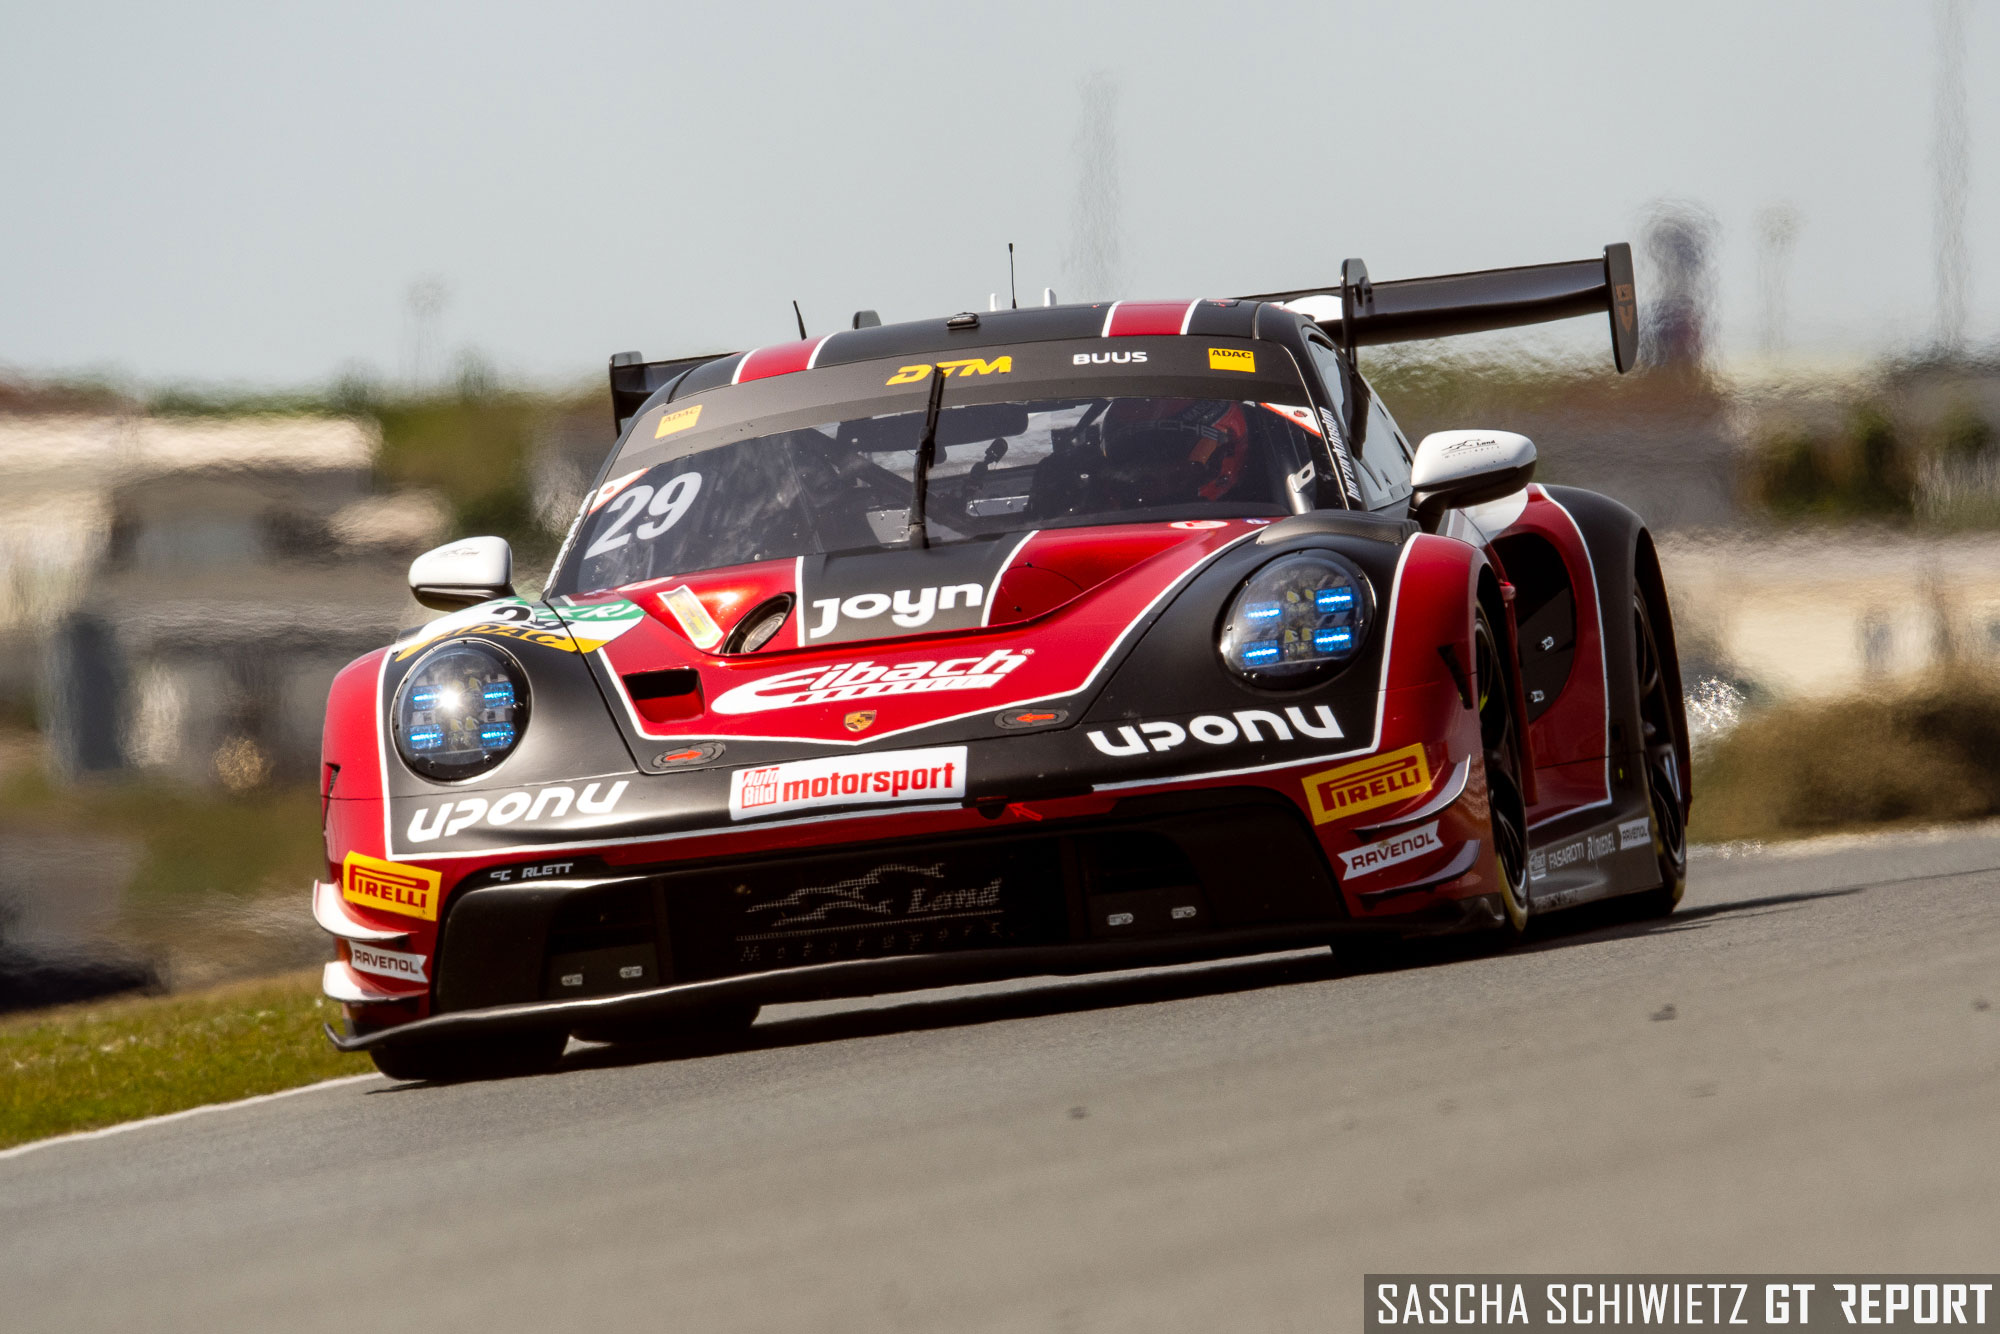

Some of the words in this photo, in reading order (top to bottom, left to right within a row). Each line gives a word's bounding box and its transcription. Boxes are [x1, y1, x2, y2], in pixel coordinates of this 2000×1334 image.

[885, 356, 1012, 385] DTM
[1073, 351, 1148, 365] BUUS
[1212, 349, 1252, 359] ADAC
[583, 471, 702, 560] 29
[711, 649, 1028, 714] Eibach
[782, 762, 955, 802] motorsport
[1317, 755, 1421, 812] PIRELLI
[1351, 832, 1434, 870] RAVENOL
[349, 864, 430, 908] PIRELLI
[354, 949, 418, 974] RAVENOL
